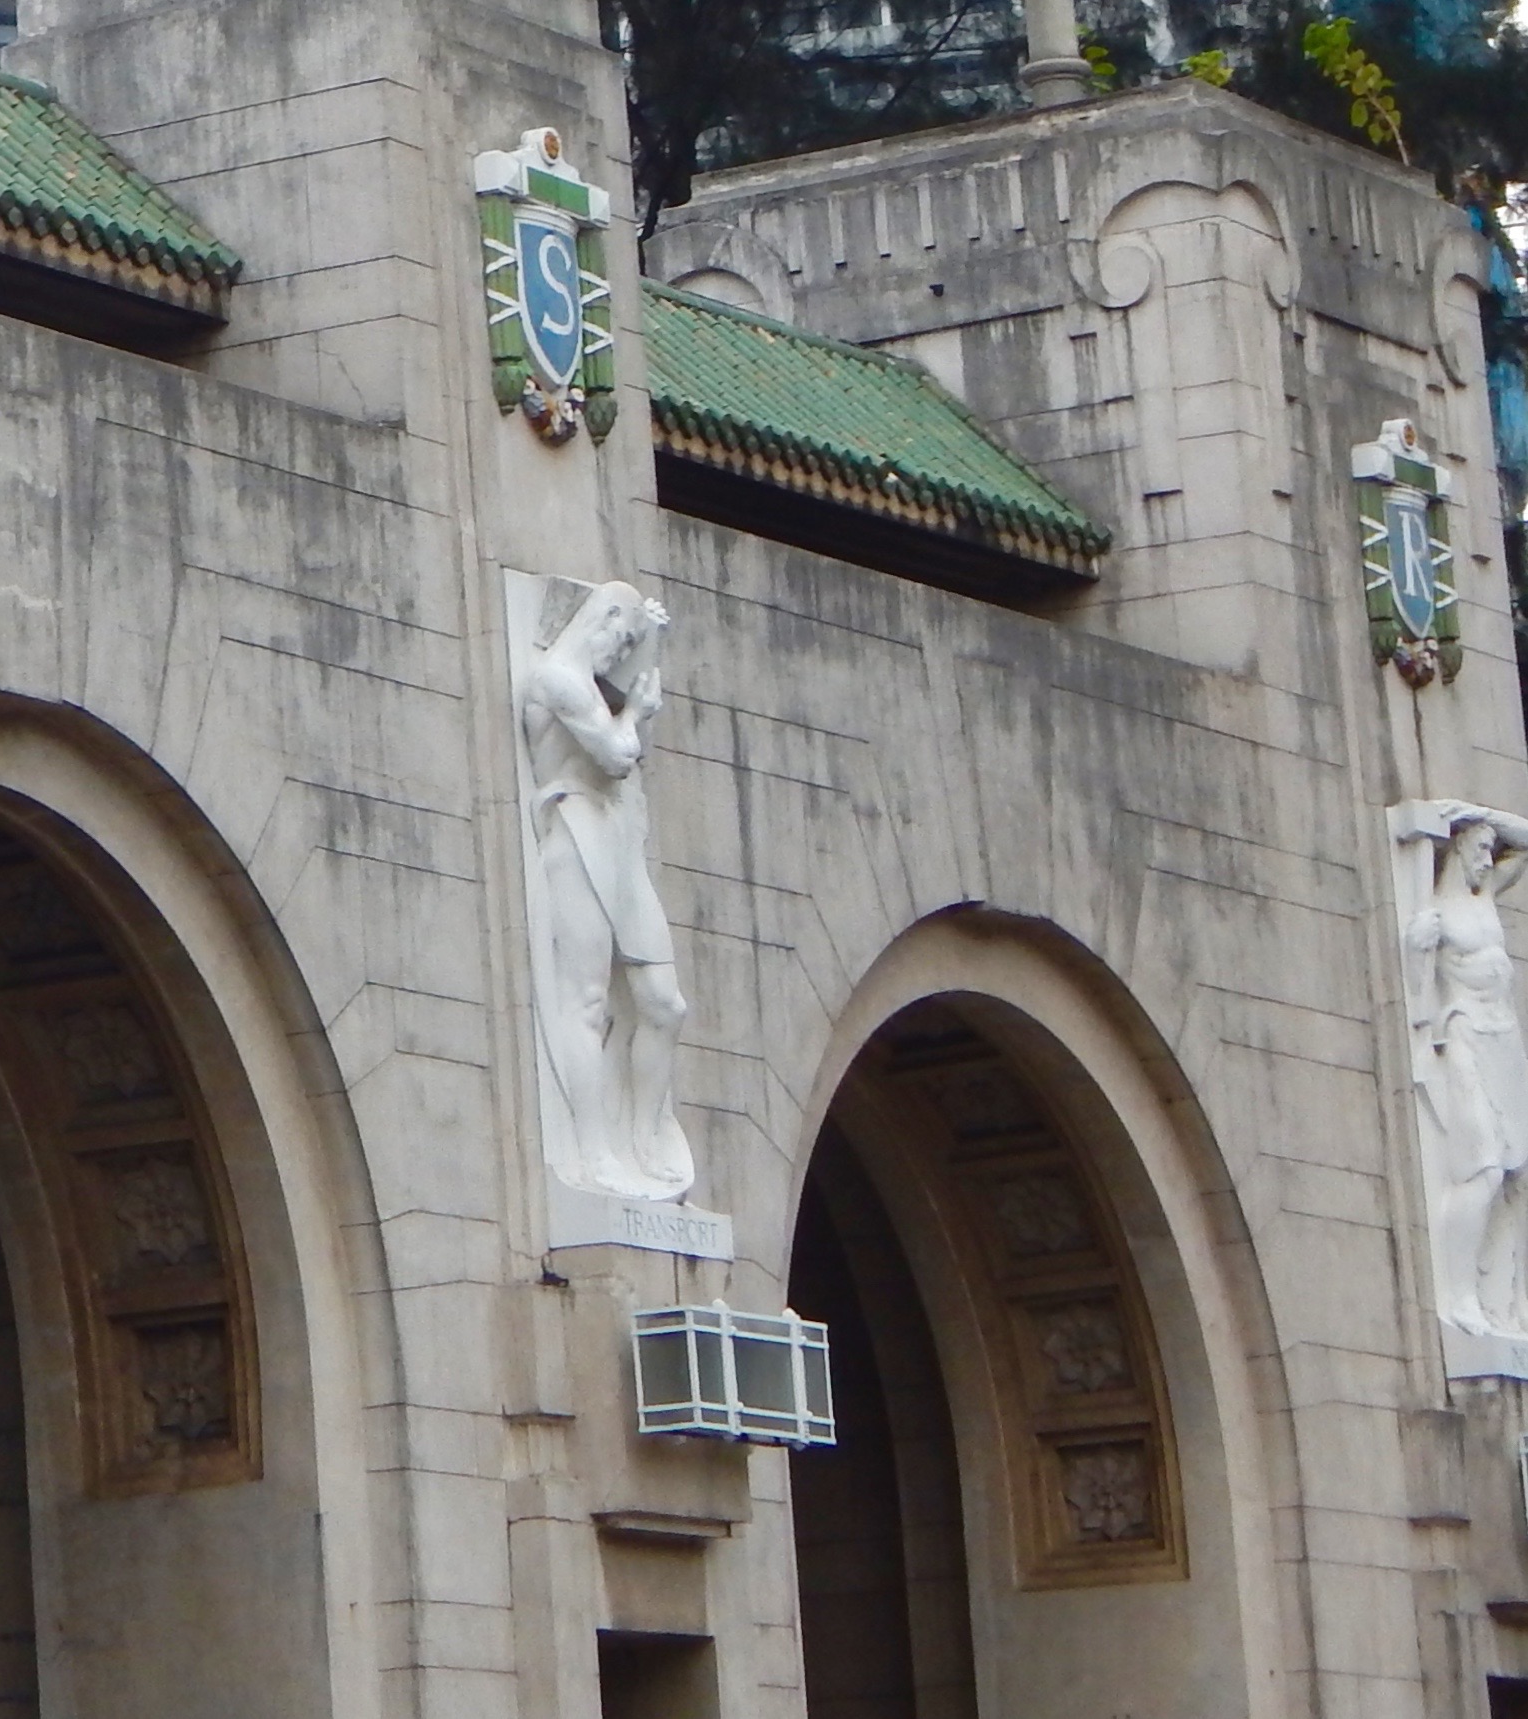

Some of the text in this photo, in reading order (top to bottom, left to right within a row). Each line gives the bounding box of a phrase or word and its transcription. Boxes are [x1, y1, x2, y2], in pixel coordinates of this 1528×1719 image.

[539, 234, 574, 336] S
[1398, 510, 1432, 603] R
[622, 1207, 719, 1248] TRANSPORT
